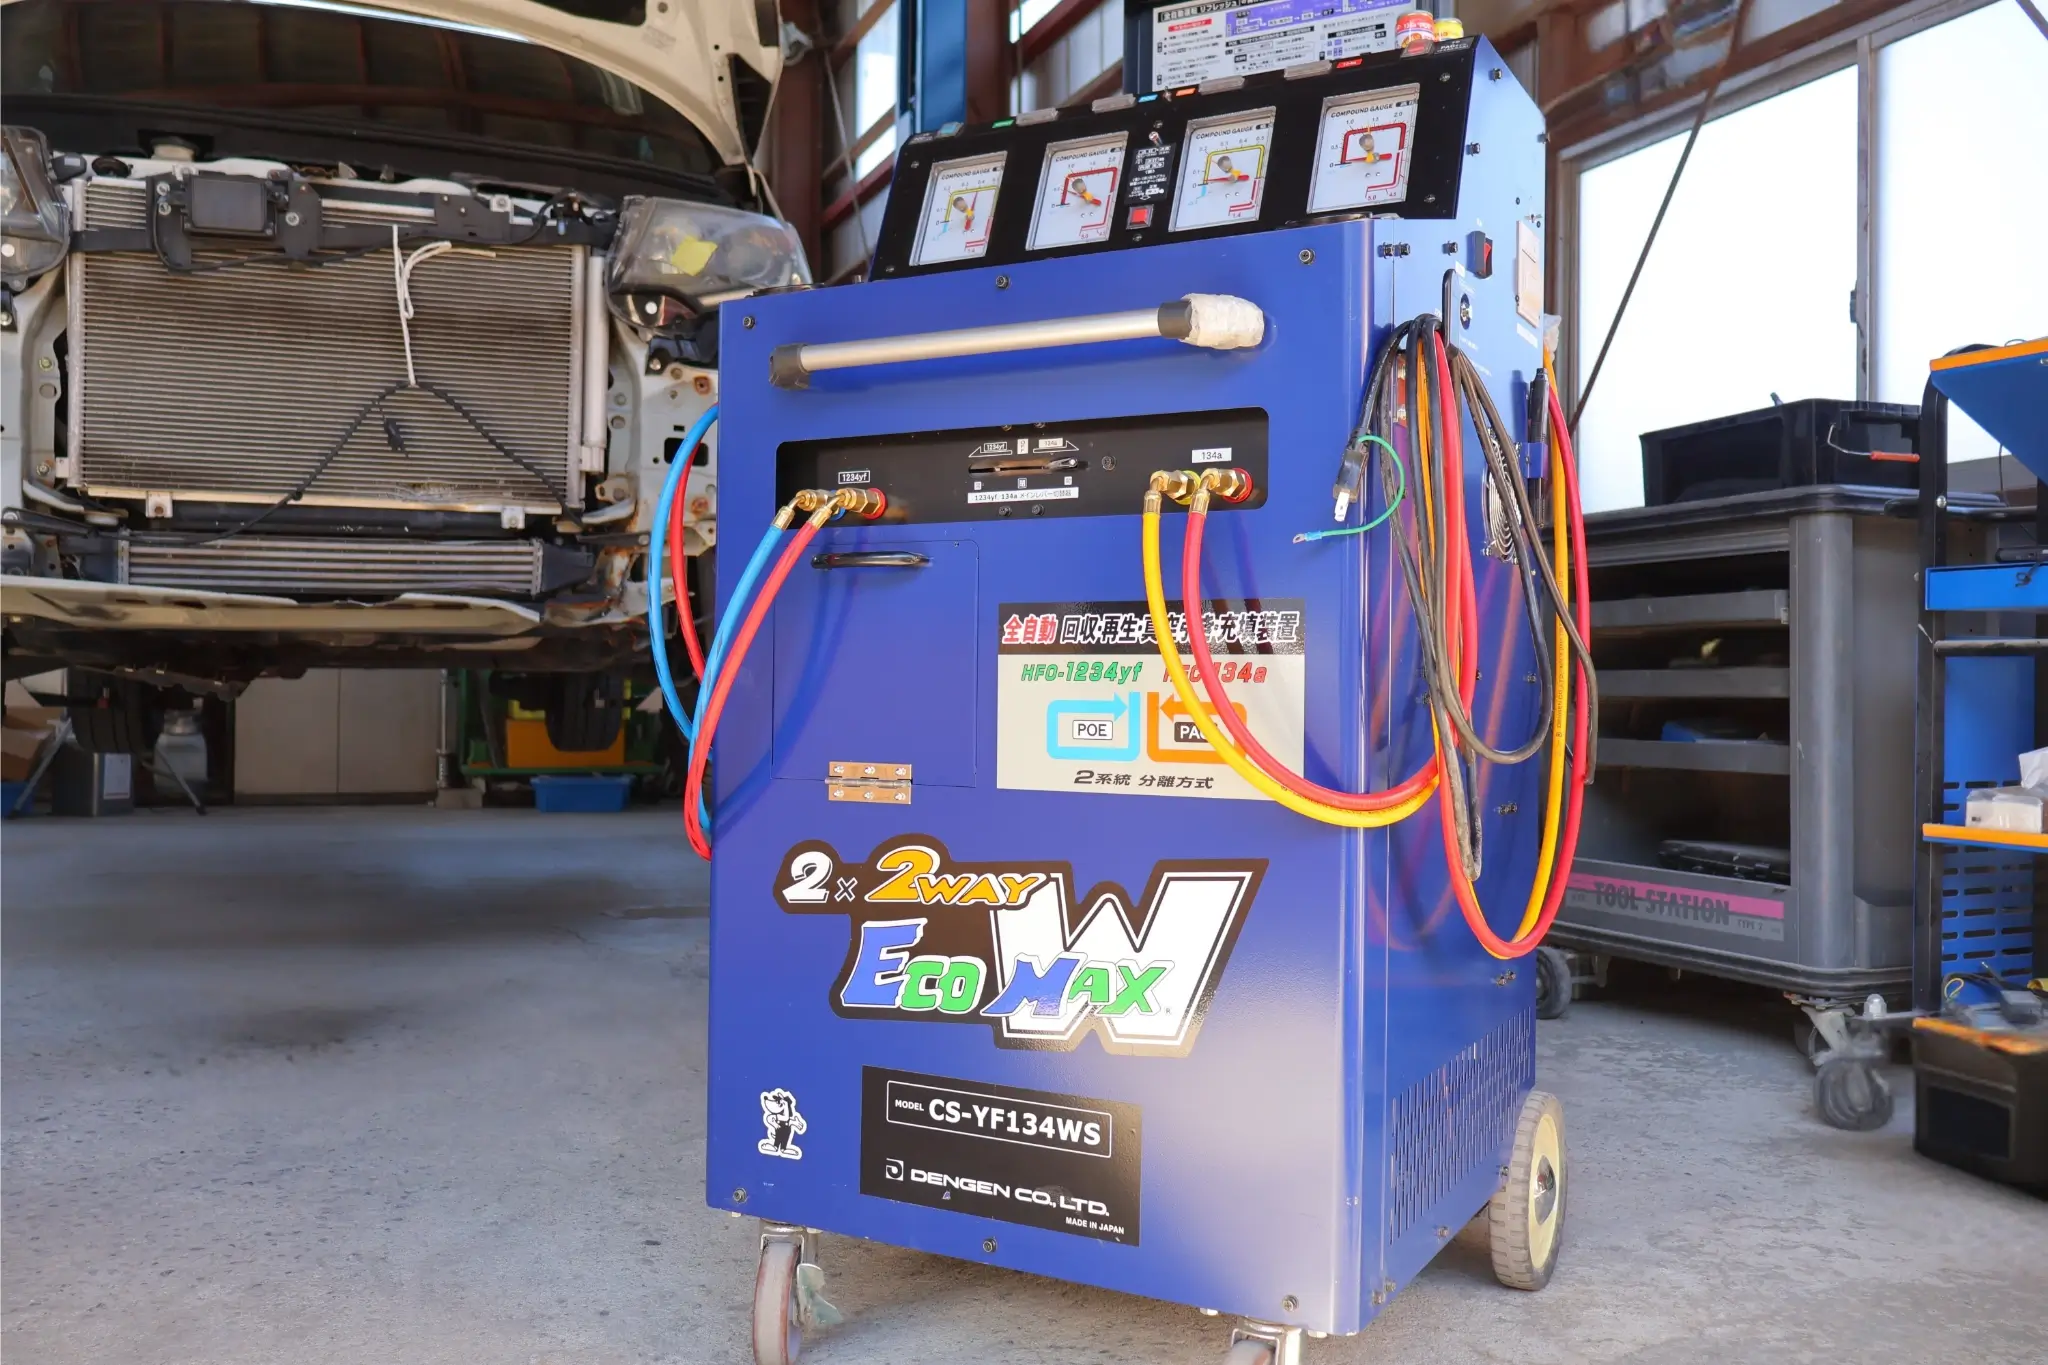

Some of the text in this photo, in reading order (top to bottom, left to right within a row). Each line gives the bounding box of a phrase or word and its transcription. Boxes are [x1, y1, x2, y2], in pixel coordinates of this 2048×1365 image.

[1331, 108, 1369, 118] COMPOUND
[1370, 103, 1394, 112] GAUGE
[1196, 129, 1231, 140] COMPOUND
[1232, 126, 1253, 134] GAUGE
[1055, 152, 1088, 162] COMPOUND
[1089, 149, 1108, 157] GAUGE
[941, 171, 971, 180] COMPOUND
[971, 168, 990, 176] GAUGE
[1202, 451, 1223, 461] 134a
[842, 472, 867, 482] 1234yf
[1002, 614, 1058, 645] 全自動
[1021, 662, 1143, 684] HFO-1234yf
[1077, 723, 1107, 737] POE
[1074, 769, 1215, 789] 2系統 分離方式
[783, 850, 834, 903] 2
[1593, 881, 1638, 911] TOOL
[1645, 888, 1730, 926] STATION
[895, 1098, 1101, 1146] MODEL CS-YF134WS
[910, 1168, 1010, 1199] DENGEN
[1066, 1217, 1124, 1235] MADE IN JAPAN
